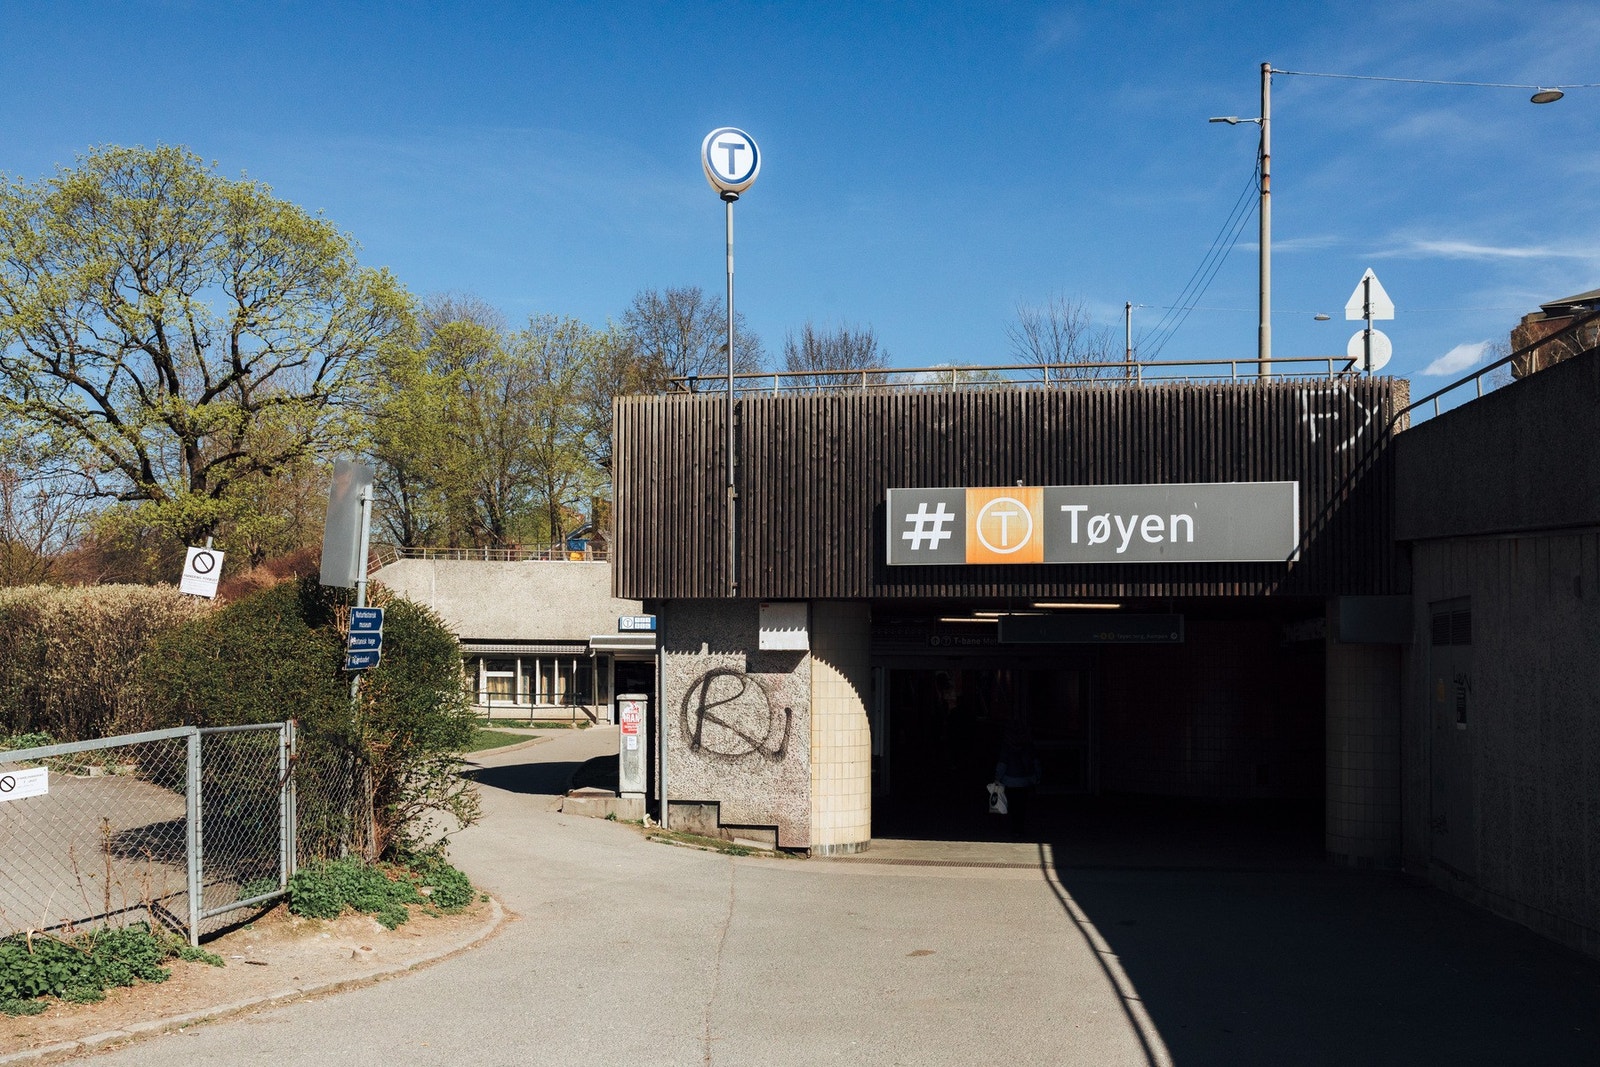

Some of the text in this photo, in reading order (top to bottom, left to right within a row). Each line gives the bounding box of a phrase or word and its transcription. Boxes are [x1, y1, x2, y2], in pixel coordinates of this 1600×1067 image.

[718, 142, 745, 175] T
[902, 502, 1194, 553] # T Tøyen
